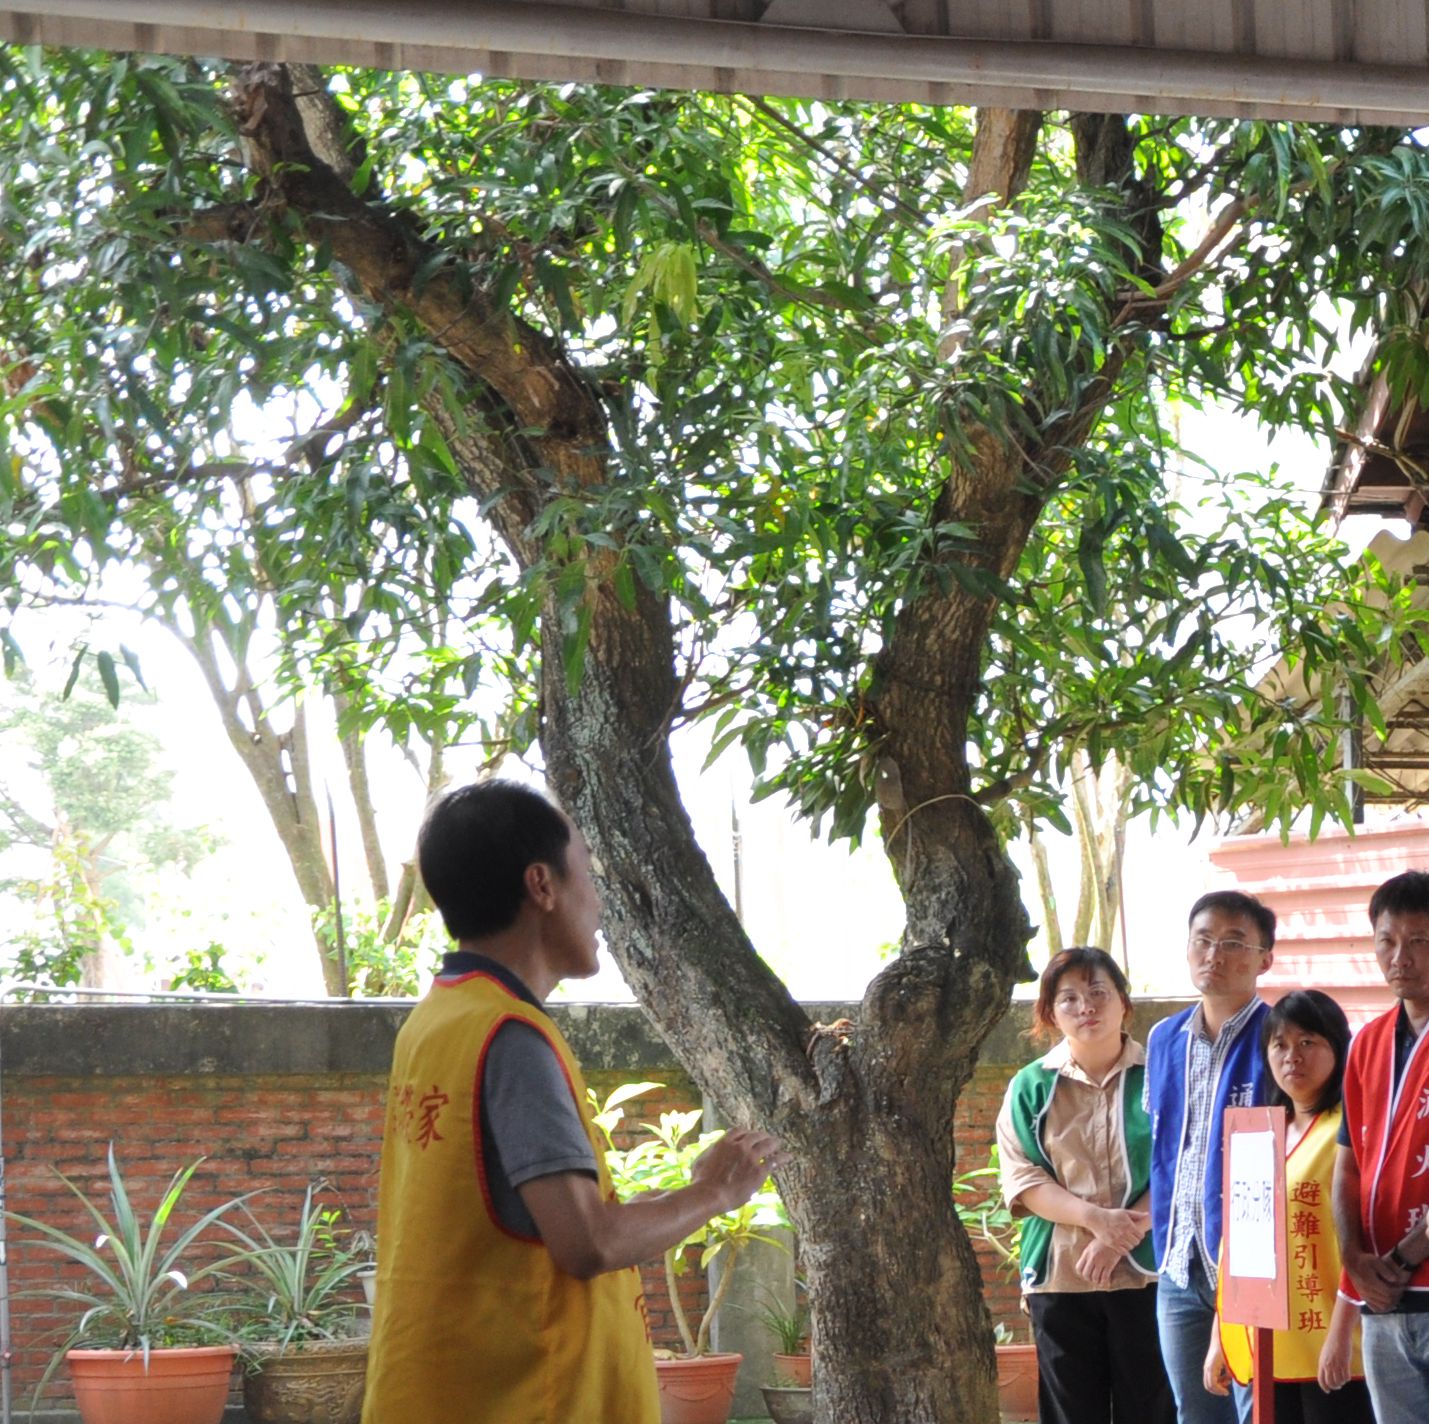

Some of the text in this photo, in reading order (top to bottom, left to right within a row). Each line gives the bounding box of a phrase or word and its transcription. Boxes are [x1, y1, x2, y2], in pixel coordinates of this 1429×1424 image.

[1289, 1179, 1327, 1334] 避難引導班
